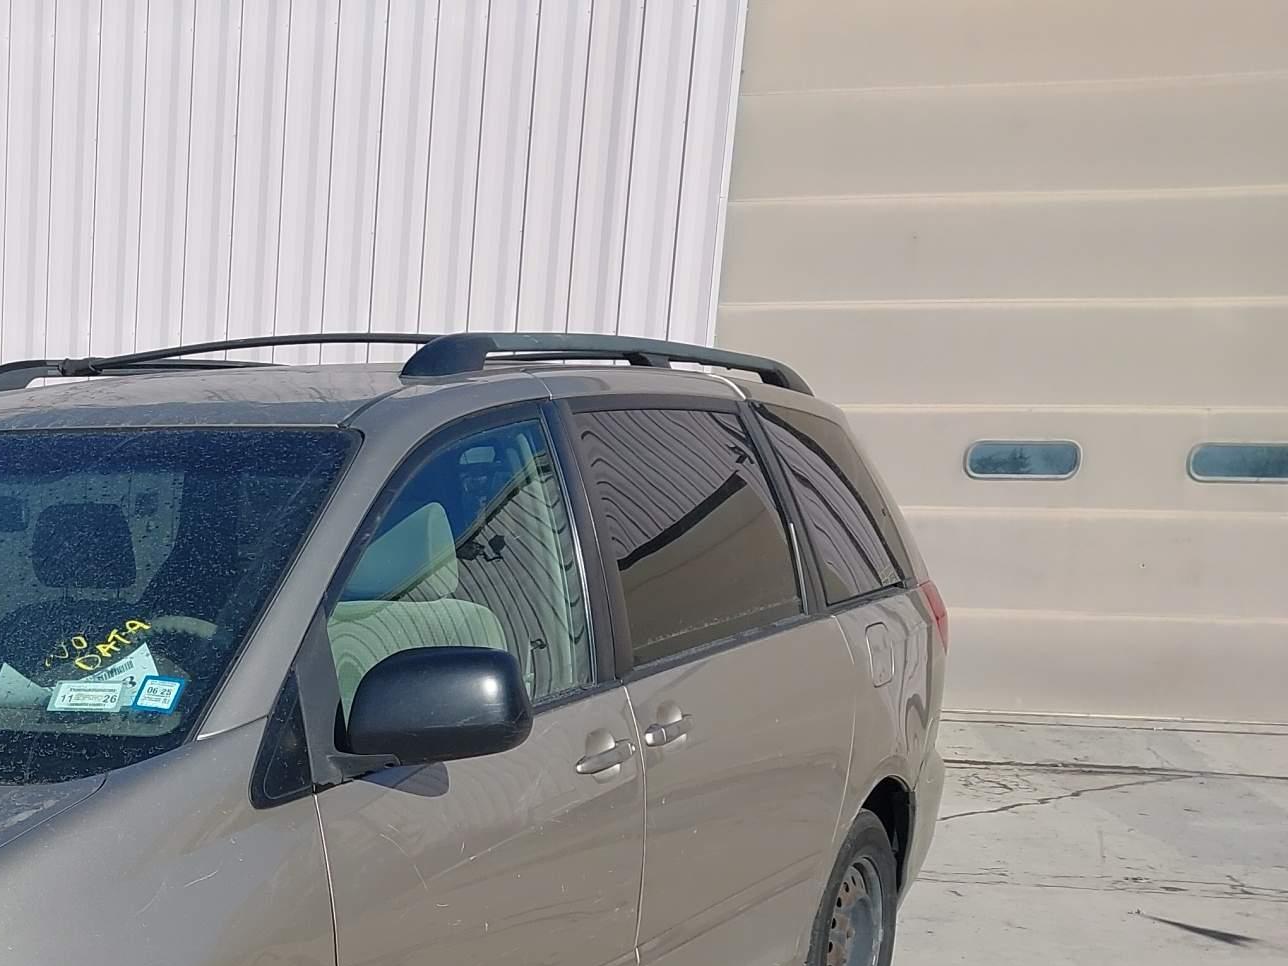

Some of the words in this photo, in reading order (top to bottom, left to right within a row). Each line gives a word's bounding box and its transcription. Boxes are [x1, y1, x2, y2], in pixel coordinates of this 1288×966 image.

[75, 620, 151, 670] DATA
[146, 686, 158, 694] 06
[159, 687, 172, 696] 25
[61, 694, 74, 703] 11
[102, 694, 118, 703] 26
